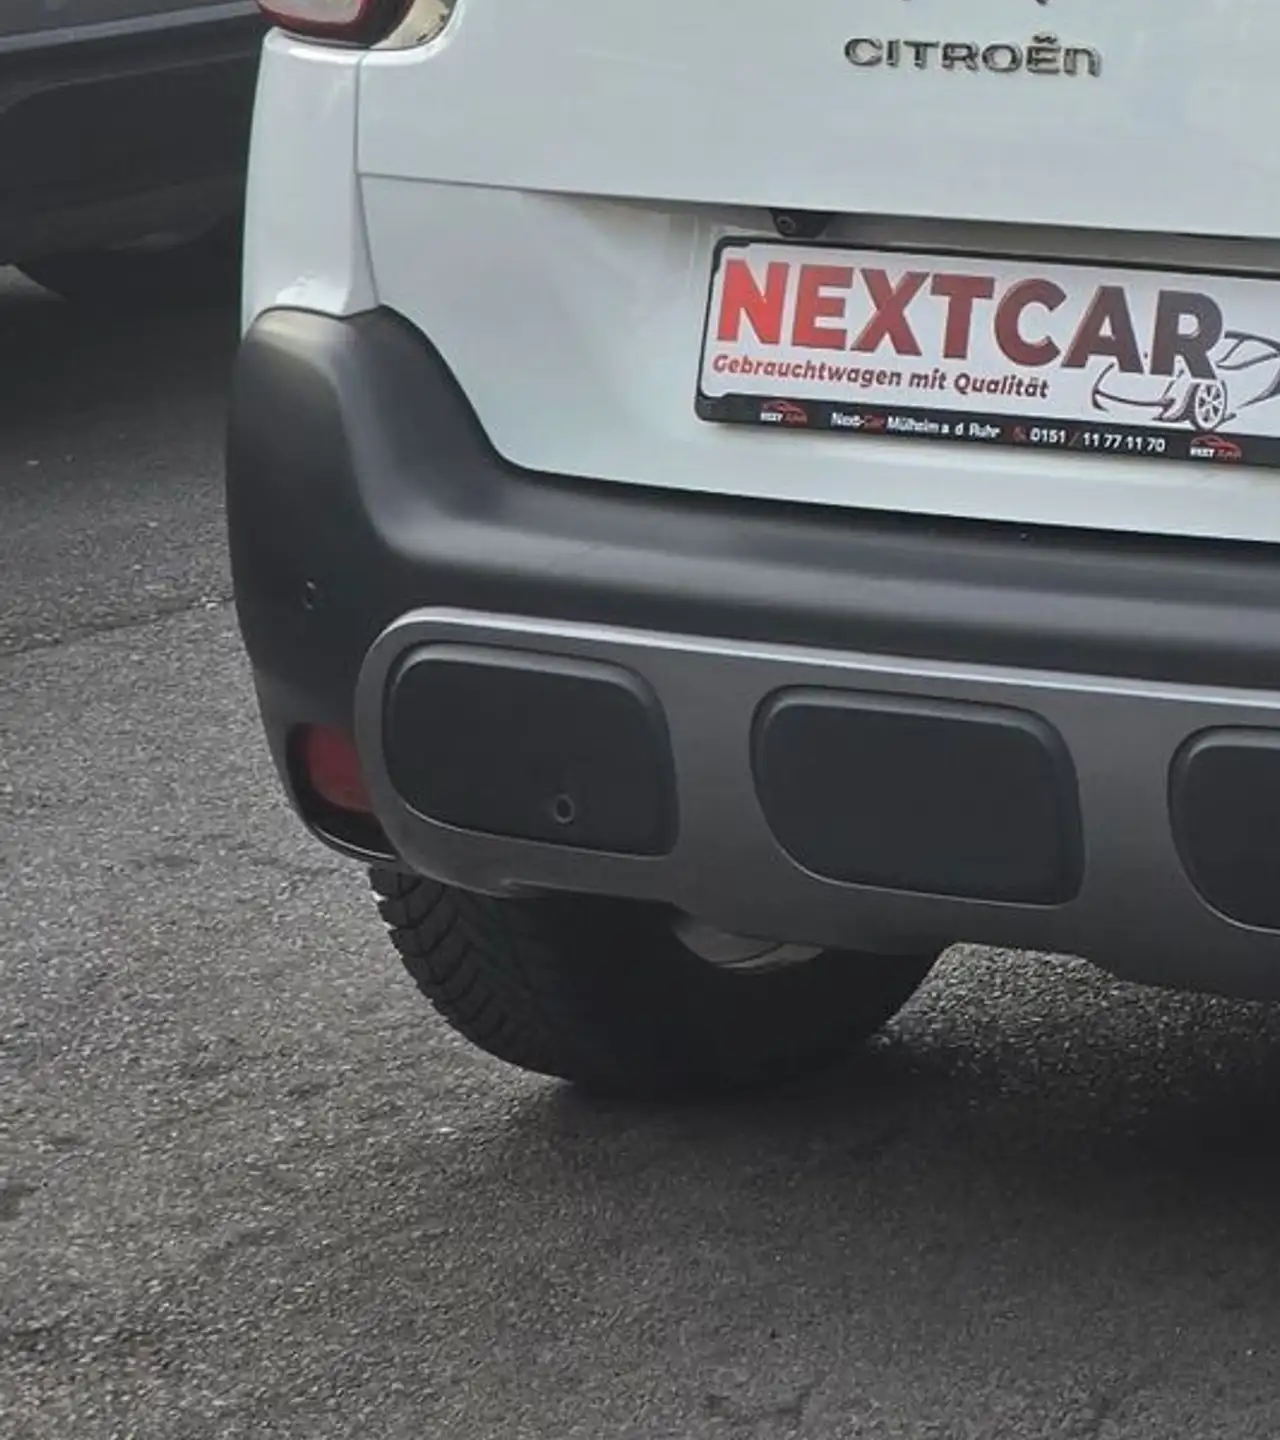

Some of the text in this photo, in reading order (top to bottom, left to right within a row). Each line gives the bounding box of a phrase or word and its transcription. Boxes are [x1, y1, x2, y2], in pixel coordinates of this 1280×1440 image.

[716, 258, 1224, 380] NEXTCAR
[711, 354, 1050, 399] Gebrauchtwagen mit Qualität
[1030, 427, 1067, 444] 0151
[1083, 432, 1100, 447] 11
[1103, 434, 1122, 449] 77
[1125, 436, 1143, 451] 11
[1146, 438, 1166, 453] 70
